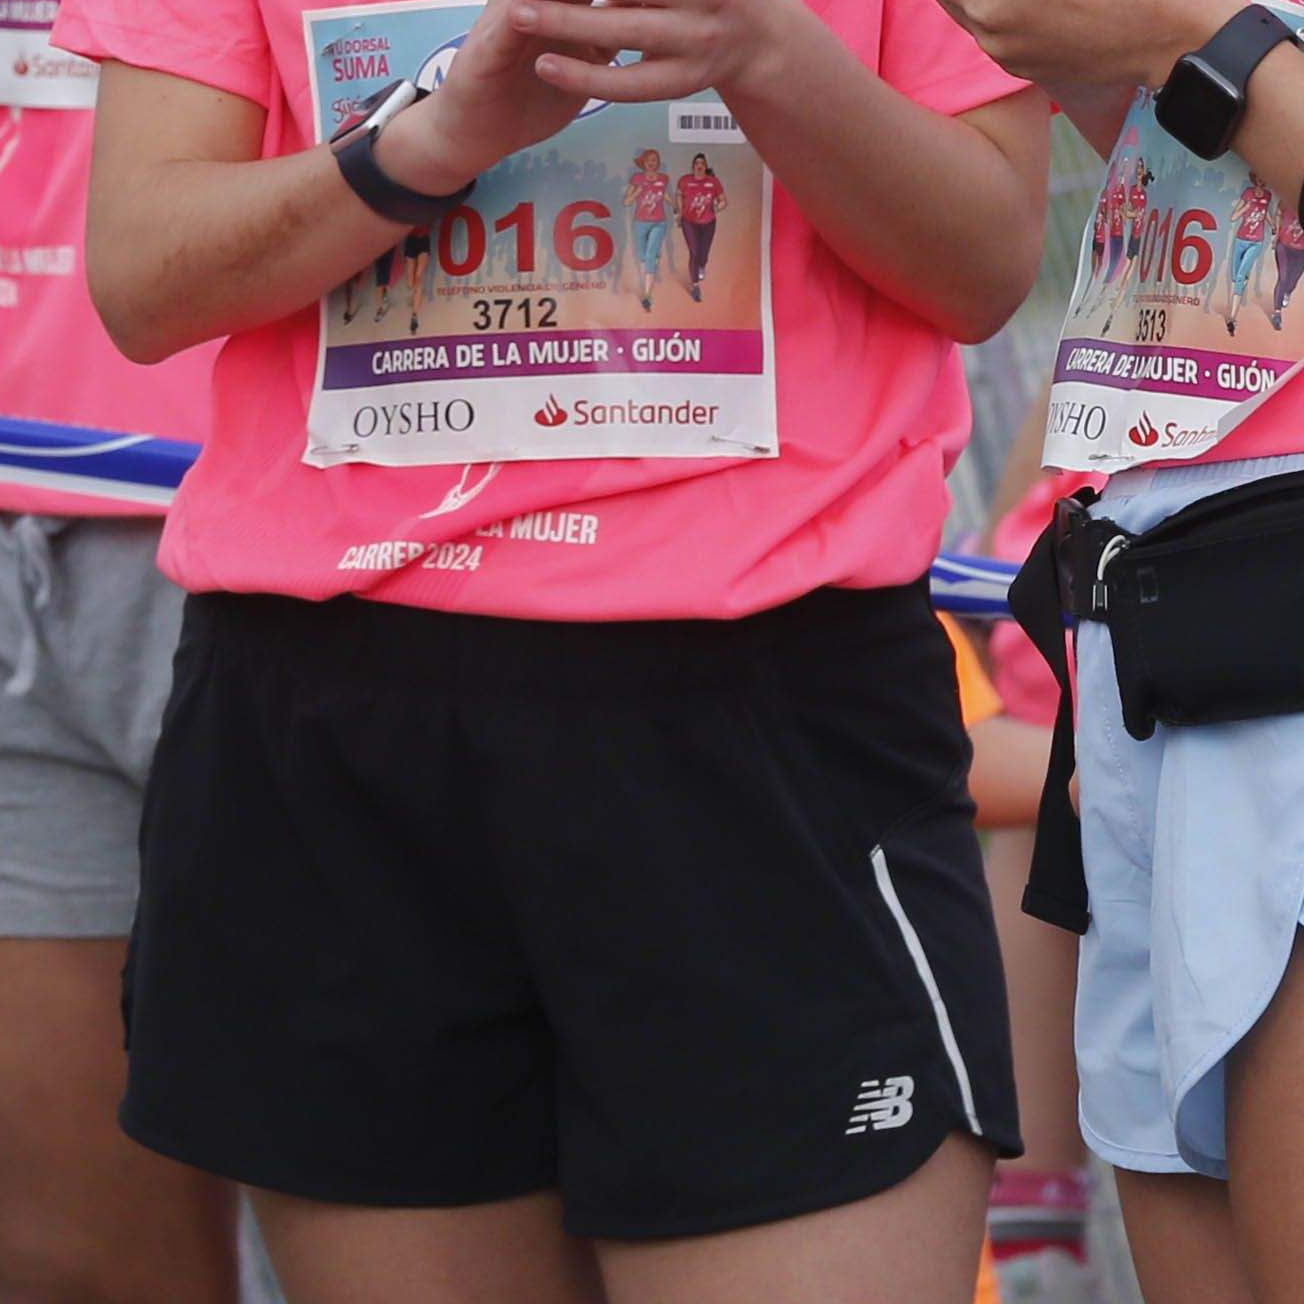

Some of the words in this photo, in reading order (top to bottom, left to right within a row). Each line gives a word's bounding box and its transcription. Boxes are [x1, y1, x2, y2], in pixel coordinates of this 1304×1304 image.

[345, 36, 391, 53] DORSAL
[332, 54, 390, 82] SUMA
[437, 199, 615, 277] 016
[1138, 207, 1218, 286] 016
[472, 297, 558, 330] 3712
[371, 347, 450, 375] CARRERA
[455, 343, 485, 368] DE
[492, 342, 522, 366] LA
[529, 338, 609, 365] MUJER
[632, 331, 701, 362] GIJÓN
[1216, 360, 1276, 394] GIJÓN
[353, 398, 475, 438] OYSHO
[574, 400, 720, 427] Santander
[509, 511, 599, 544] MUJER
[421, 542, 484, 571] 2024
